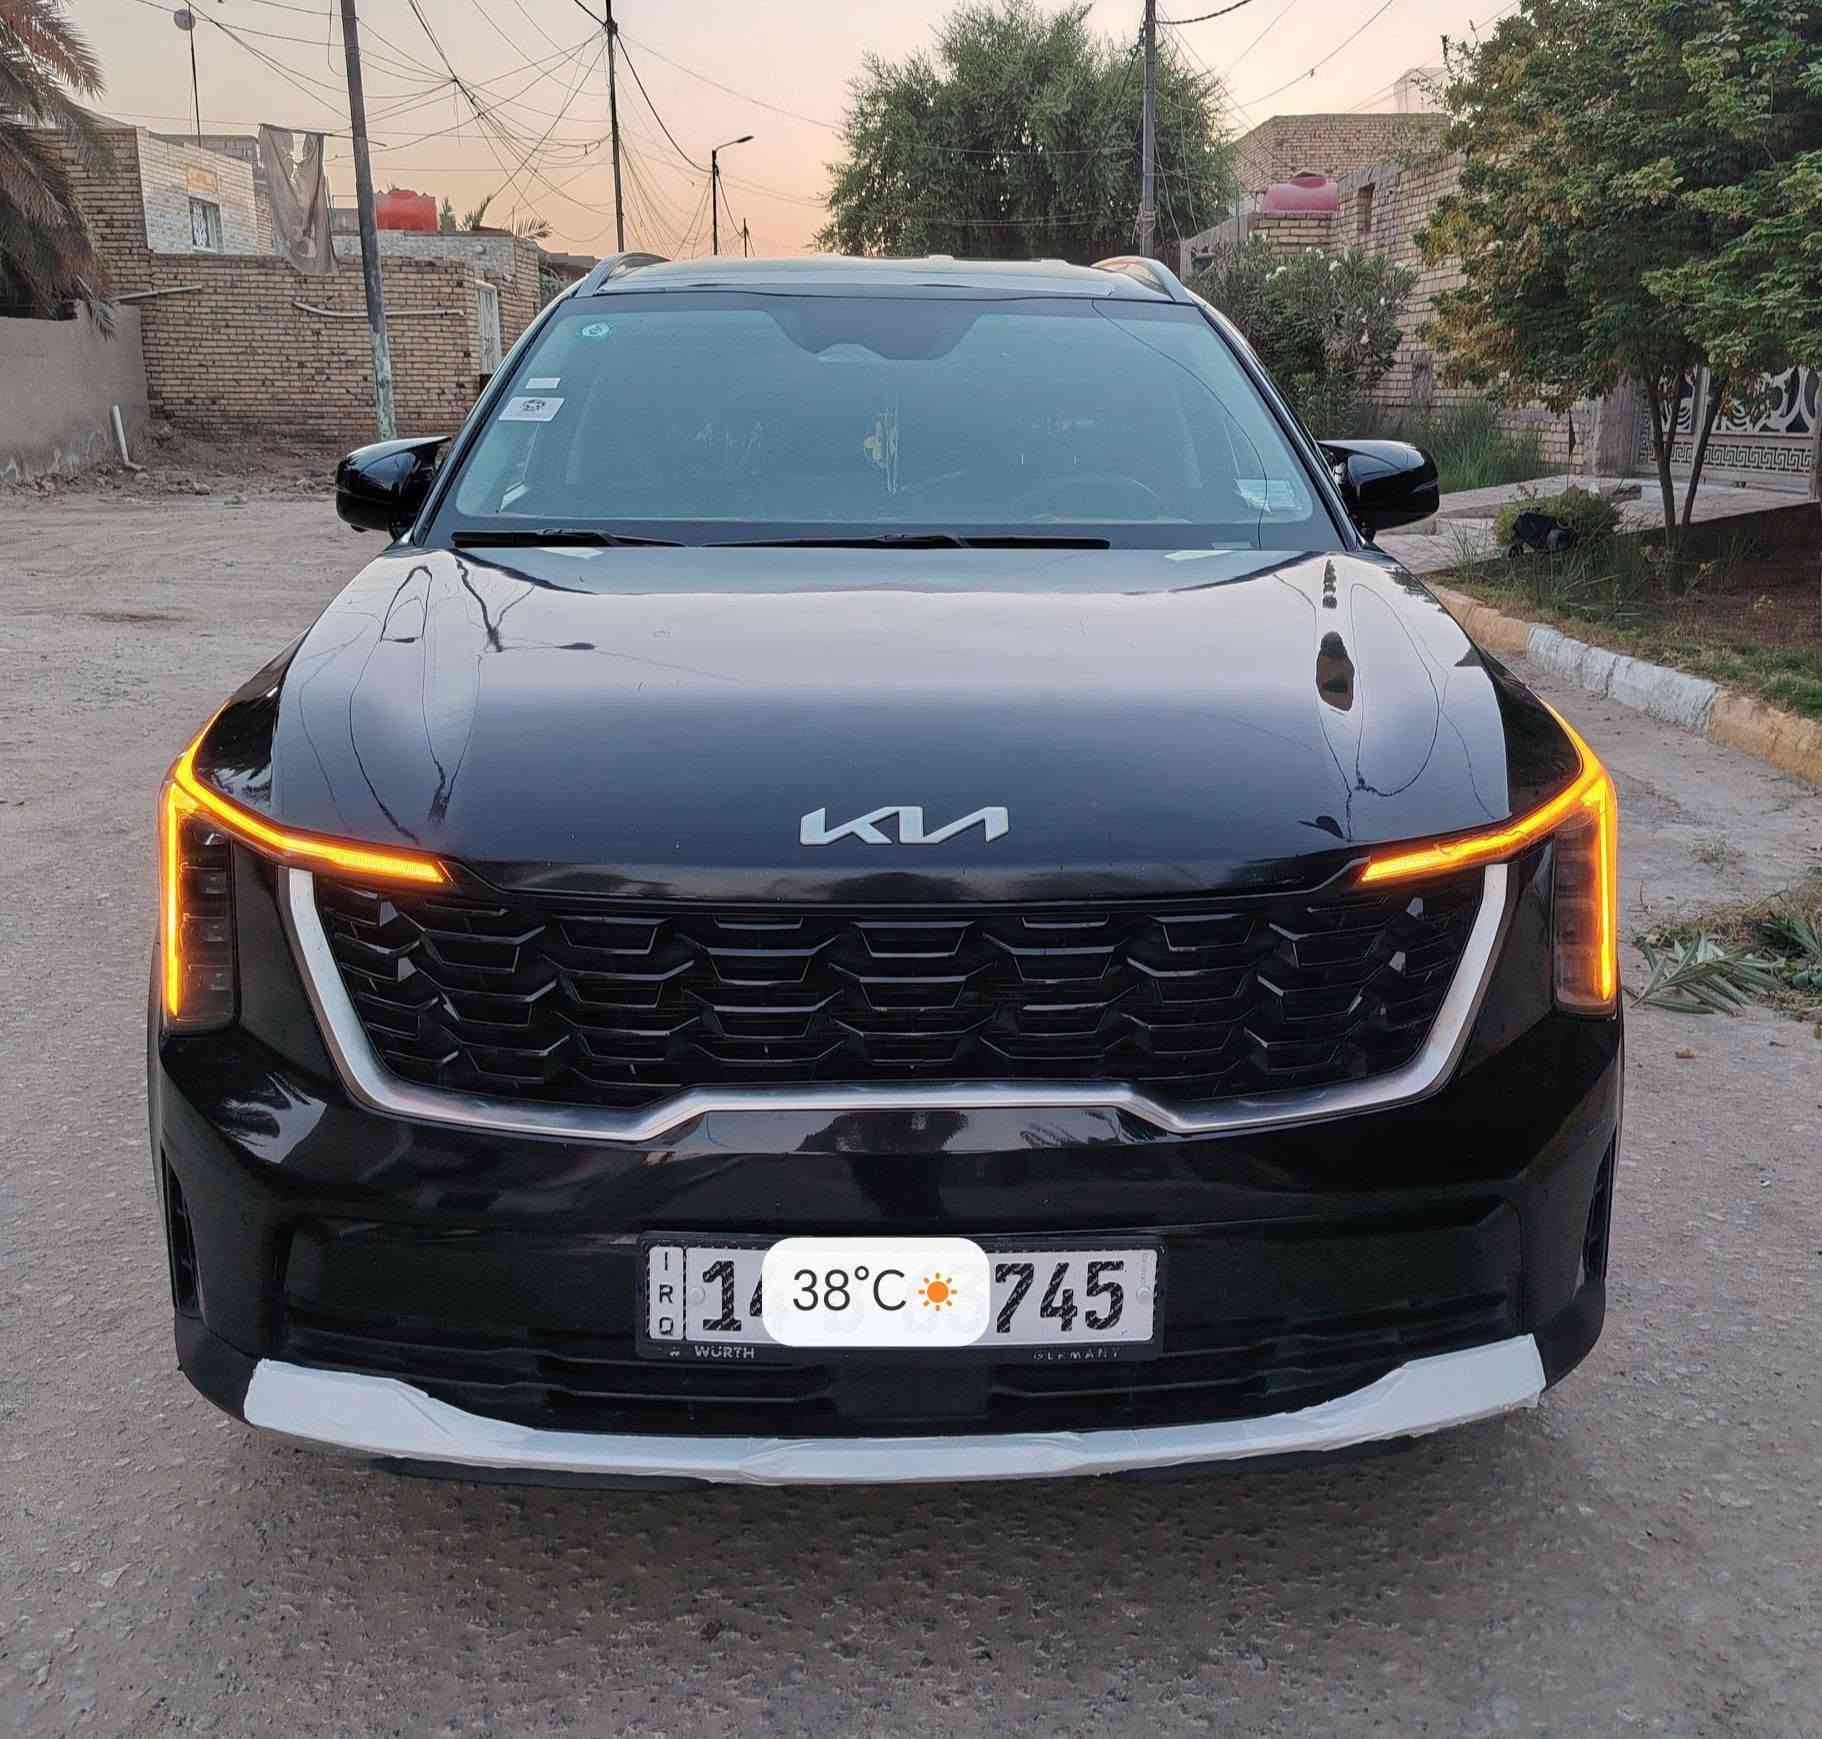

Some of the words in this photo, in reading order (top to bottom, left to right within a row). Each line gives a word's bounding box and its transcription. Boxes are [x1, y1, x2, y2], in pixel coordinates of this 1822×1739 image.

[801, 806, 1009, 845] KIA
[659, 1251, 674, 1336] IRQ
[995, 1260, 1124, 1333] 745
